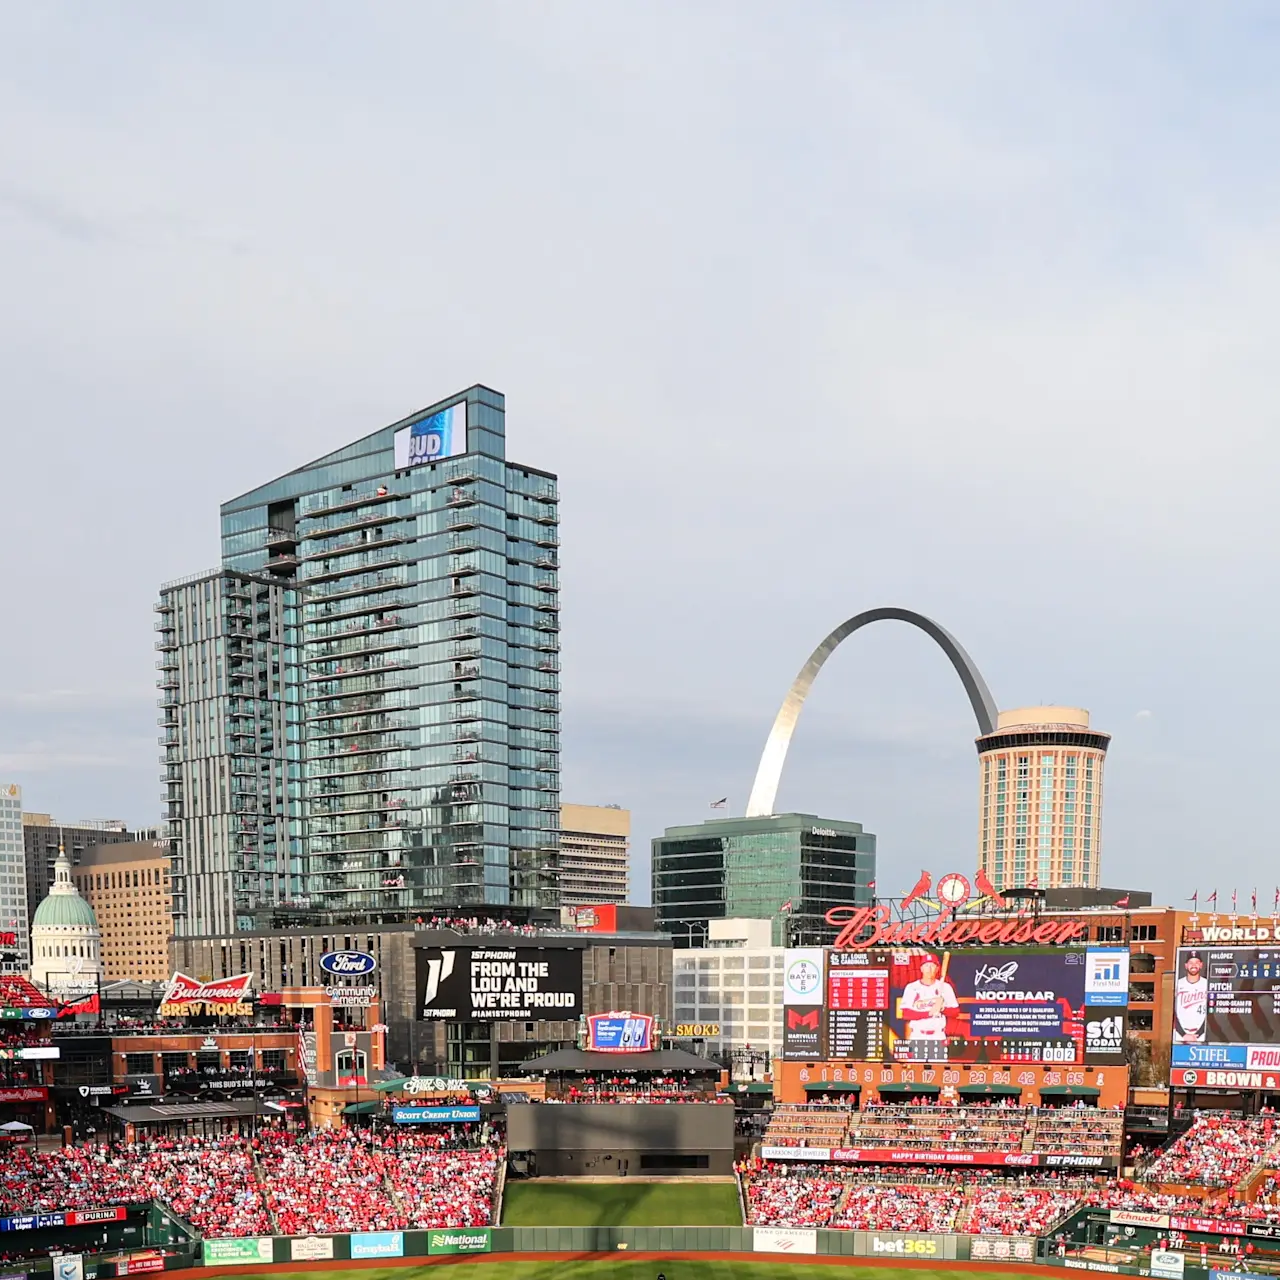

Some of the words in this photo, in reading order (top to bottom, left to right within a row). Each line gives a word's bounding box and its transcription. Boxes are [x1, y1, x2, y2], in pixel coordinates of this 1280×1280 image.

[410, 434, 440, 456] BUD
[824, 906, 1088, 949] Budweiser
[1201, 927, 1269, 941] WORLD
[332, 954, 366, 971] Ford
[1065, 953, 1084, 964] 21
[471, 962, 515, 976] FROM
[518, 962, 548, 977] THE
[160, 981, 252, 1000] Budweiser
[326, 986, 377, 997] Community
[471, 978, 501, 992] LOU
[504, 978, 538, 992] AND
[1209, 983, 1232, 991] PITCH
[471, 993, 520, 1007] WE'RE
[524, 993, 575, 1007] PROUD
[976, 991, 1054, 1000] NOOTBAAR
[161, 1003, 201, 1016] BREW
[206, 1003, 254, 1016] HOUSE
[677, 1024, 720, 1036] SMOKE
[1086, 1016, 1123, 1039] stl
[1086, 1039, 1121, 1047] TODAY
[1189, 1046, 1231, 1062] STIFEL
[821, 1069, 827, 1082] 1
[834, 1069, 842, 1082] 2
[849, 1069, 857, 1082] 6
[881, 1069, 893, 1082] 10
[901, 1070, 914, 1083] 14
[922, 1070, 935, 1083] 17
[943, 1070, 960, 1083] 20
[969, 1070, 987, 1083] 23
[993, 1071, 1010, 1084] 24
[1018, 1071, 1035, 1084] 42
[1043, 1071, 1060, 1084] 45
[1067, 1071, 1084, 1084] 85
[1207, 1072, 1262, 1087] BROWN
[1266, 1076, 1276, 1087] &
[209, 1081, 222, 1089] THIS
[396, 1111, 420, 1120] SCOTT
[422, 1110, 450, 1119] CREDIT
[452, 1110, 477, 1118] UNION
[834, 1150, 861, 1160] Coca-Cola
[891, 1152, 913, 1160] HAPPY
[1005, 1153, 1032, 1164] Coca-Cola
[84, 1211, 115, 1220] PURINA
[1114, 1212, 1162, 1223] Schnucks
[1252, 1228, 1269, 1236] Mercy
[444, 1234, 488, 1245] National
[873, 1237, 936, 1254] bet365
[1065, 1259, 1087, 1269] BUSCH
[1088, 1261, 1119, 1272] STADIUM
